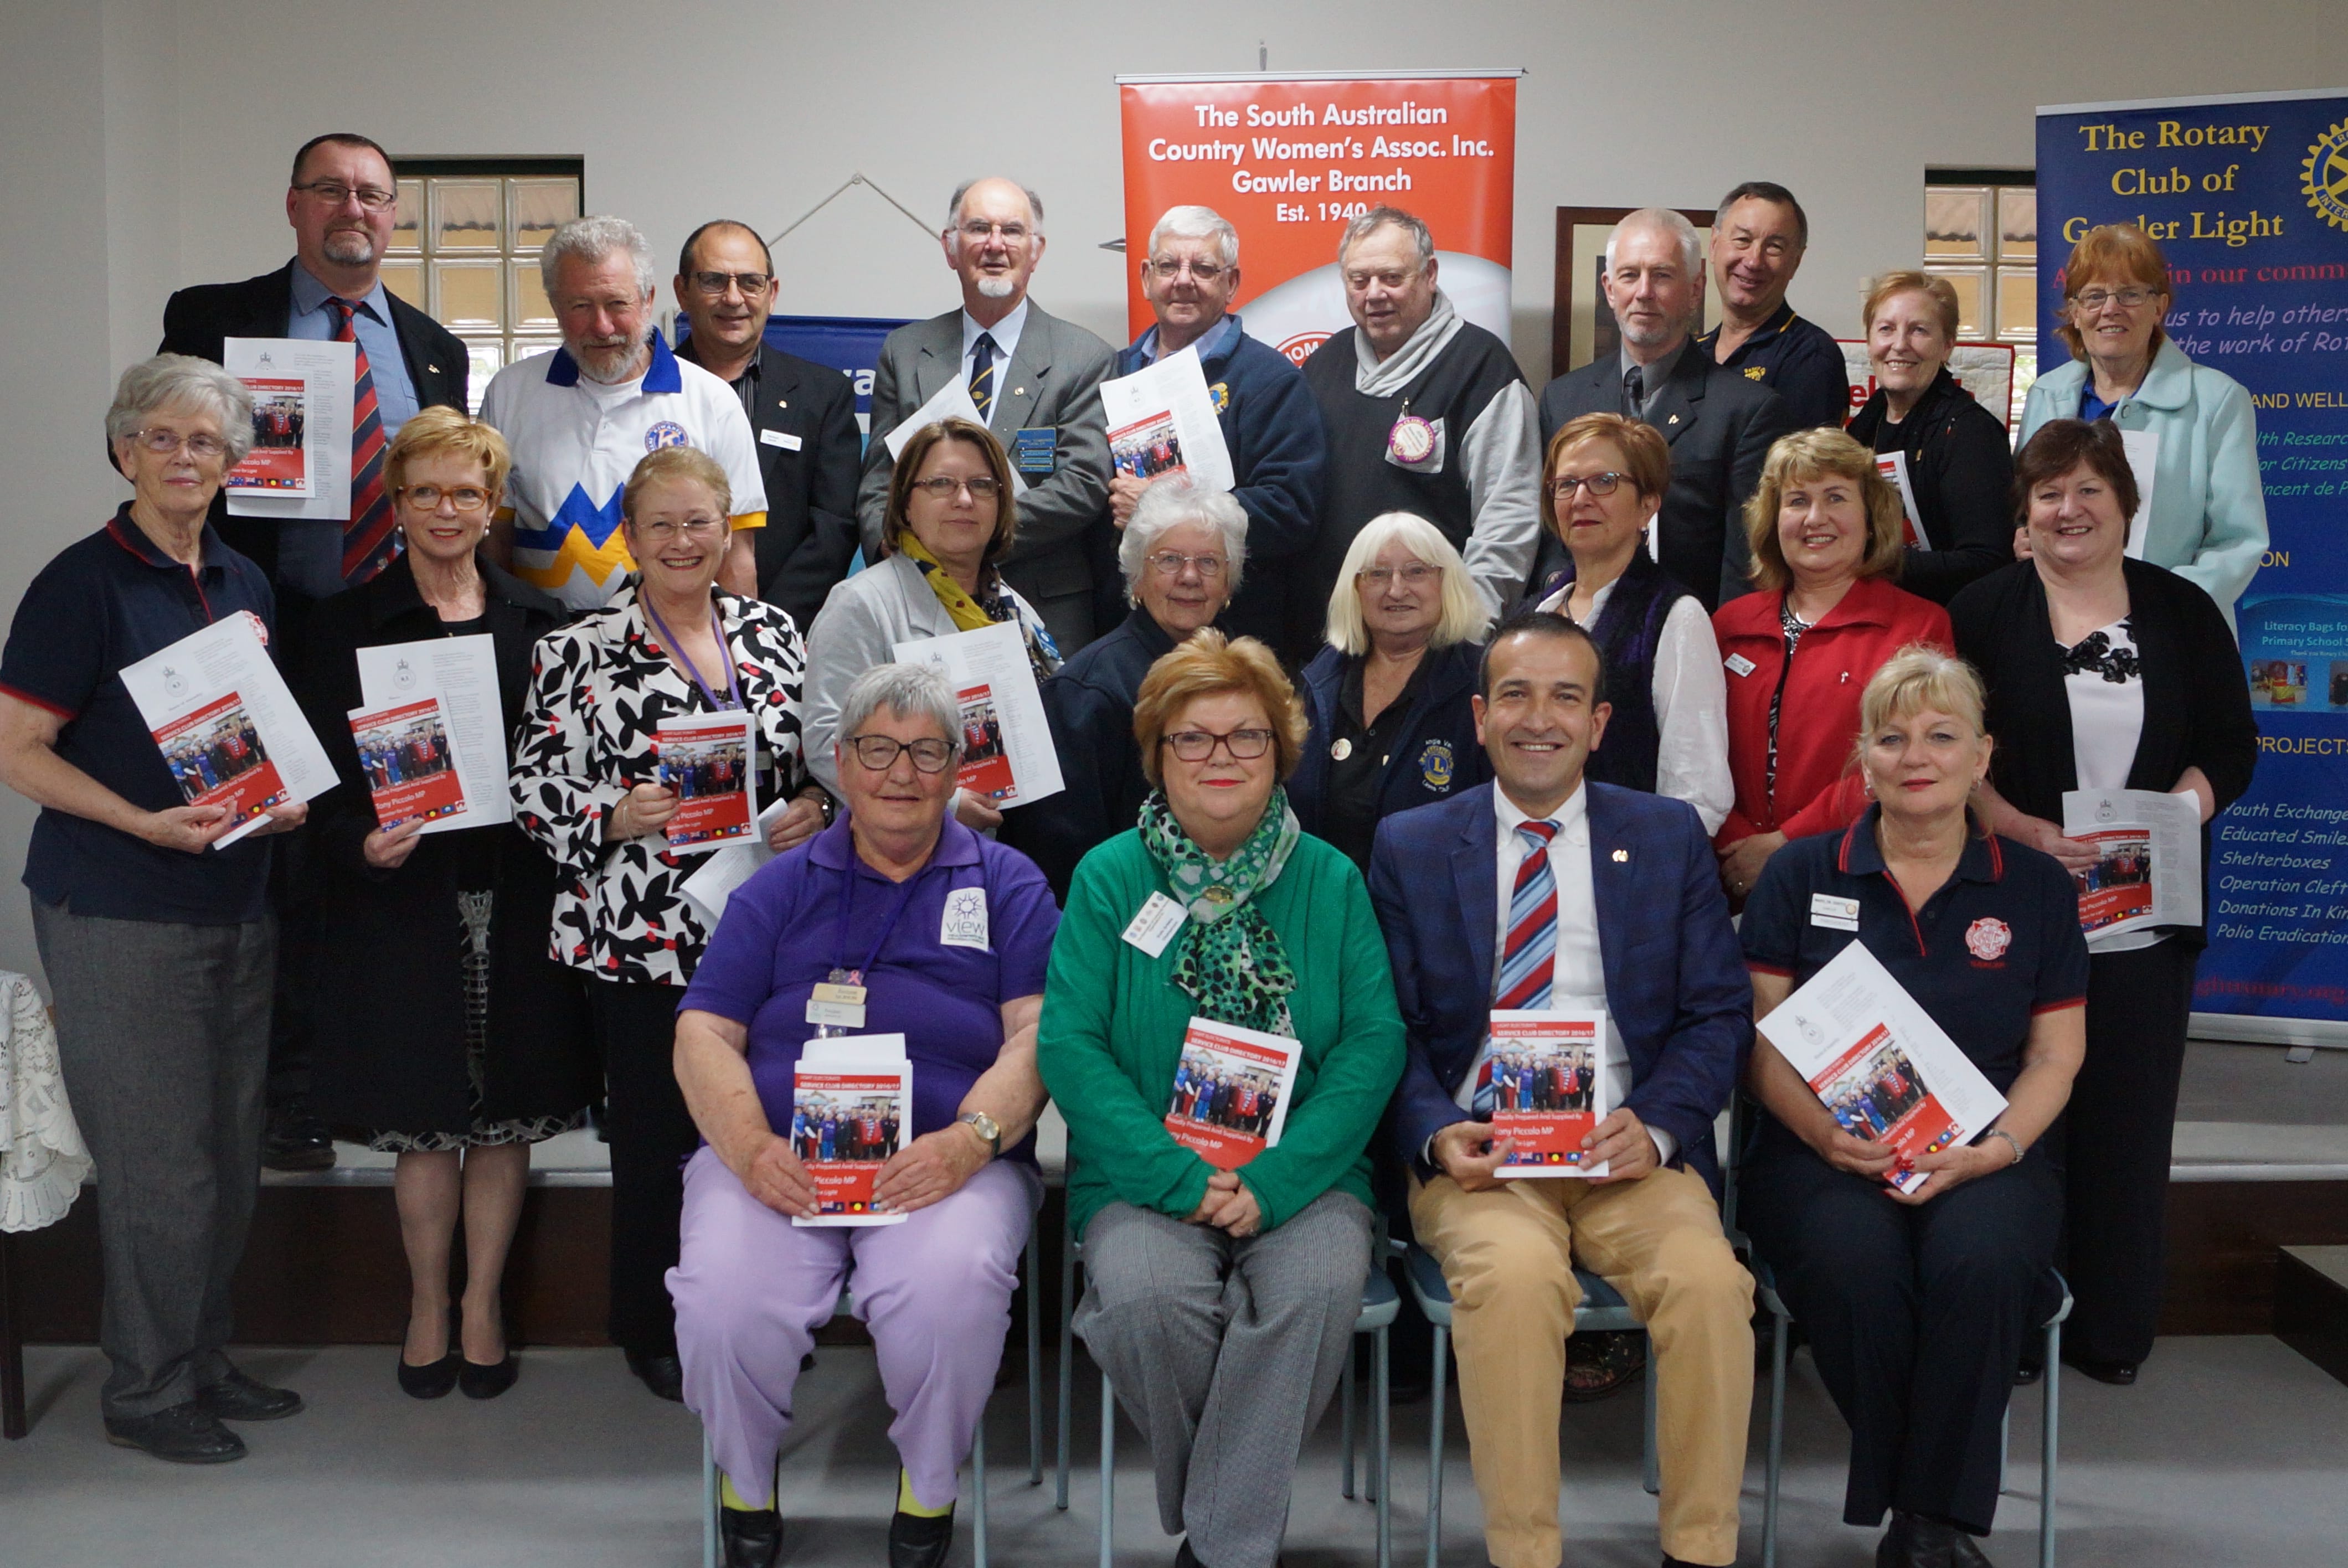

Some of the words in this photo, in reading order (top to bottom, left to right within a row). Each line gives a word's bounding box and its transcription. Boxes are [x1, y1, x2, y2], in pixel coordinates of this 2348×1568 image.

[1194, 105, 1239, 127] The
[1247, 104, 1315, 126] South
[1323, 102, 1447, 126] Australian
[2079, 125, 2145, 152] The
[2156, 121, 2270, 152] Rotary
[1149, 138, 1244, 165] Country
[1253, 136, 1363, 159] Women's
[1371, 136, 1446, 158] Assoc.
[1453, 135, 1494, 157] Inc.
[1232, 170, 1321, 193] Gawler
[1329, 169, 1412, 192] Branch
[2111, 167, 2191, 195] Club
[2202, 164, 2239, 191] of
[1276, 203, 1310, 221] Est.
[1318, 202, 1367, 221] 1940
[2063, 214, 2180, 244] Gler
[2190, 211, 2284, 247] Light
[2201, 266, 2247, 284] our
[2165, 310, 2188, 327] us
[2197, 308, 2220, 326] to
[2227, 304, 2276, 331] help
[2219, 333, 2275, 354] work
[2280, 332, 2310, 354] of
[2252, 393, 2290, 409] AND
[2314, 480, 2335, 496] de
[2264, 621, 2306, 633] Literacy
[2309, 622, 2335, 633] Bags
[2262, 636, 2305, 647] Primary
[2306, 636, 2342, 646] School
[2256, 736, 2348, 755] ROJECT
[2224, 802, 2269, 818] Youth
[2274, 803, 2348, 824] Exchange
[2220, 826, 2298, 843] Educated
[2220, 852, 2331, 870] Shelterboxes
[2219, 875, 2300, 894] Operation
[2305, 879, 2348, 895] Cleft
[2218, 900, 2298, 917] Donations
[2301, 904, 2321, 918] In
[946, 919, 985, 936] view
[2216, 923, 2254, 940] Polio
[1191, 1037, 1214, 1049] SERVICE
[1213, 1043, 1230, 1053] CLUB
[1229, 1047, 1262, 1061] DIRECTORY
[1262, 1056, 1287, 1067] 2016/17
[1513, 1126, 1541, 1136] Piccolo
[1541, 1126, 1554, 1136] MP
[1181, 1132, 1209, 1147] Piccolo
[1208, 1139, 1223, 1149] MP
[843, 1175, 858, 1185] MP
